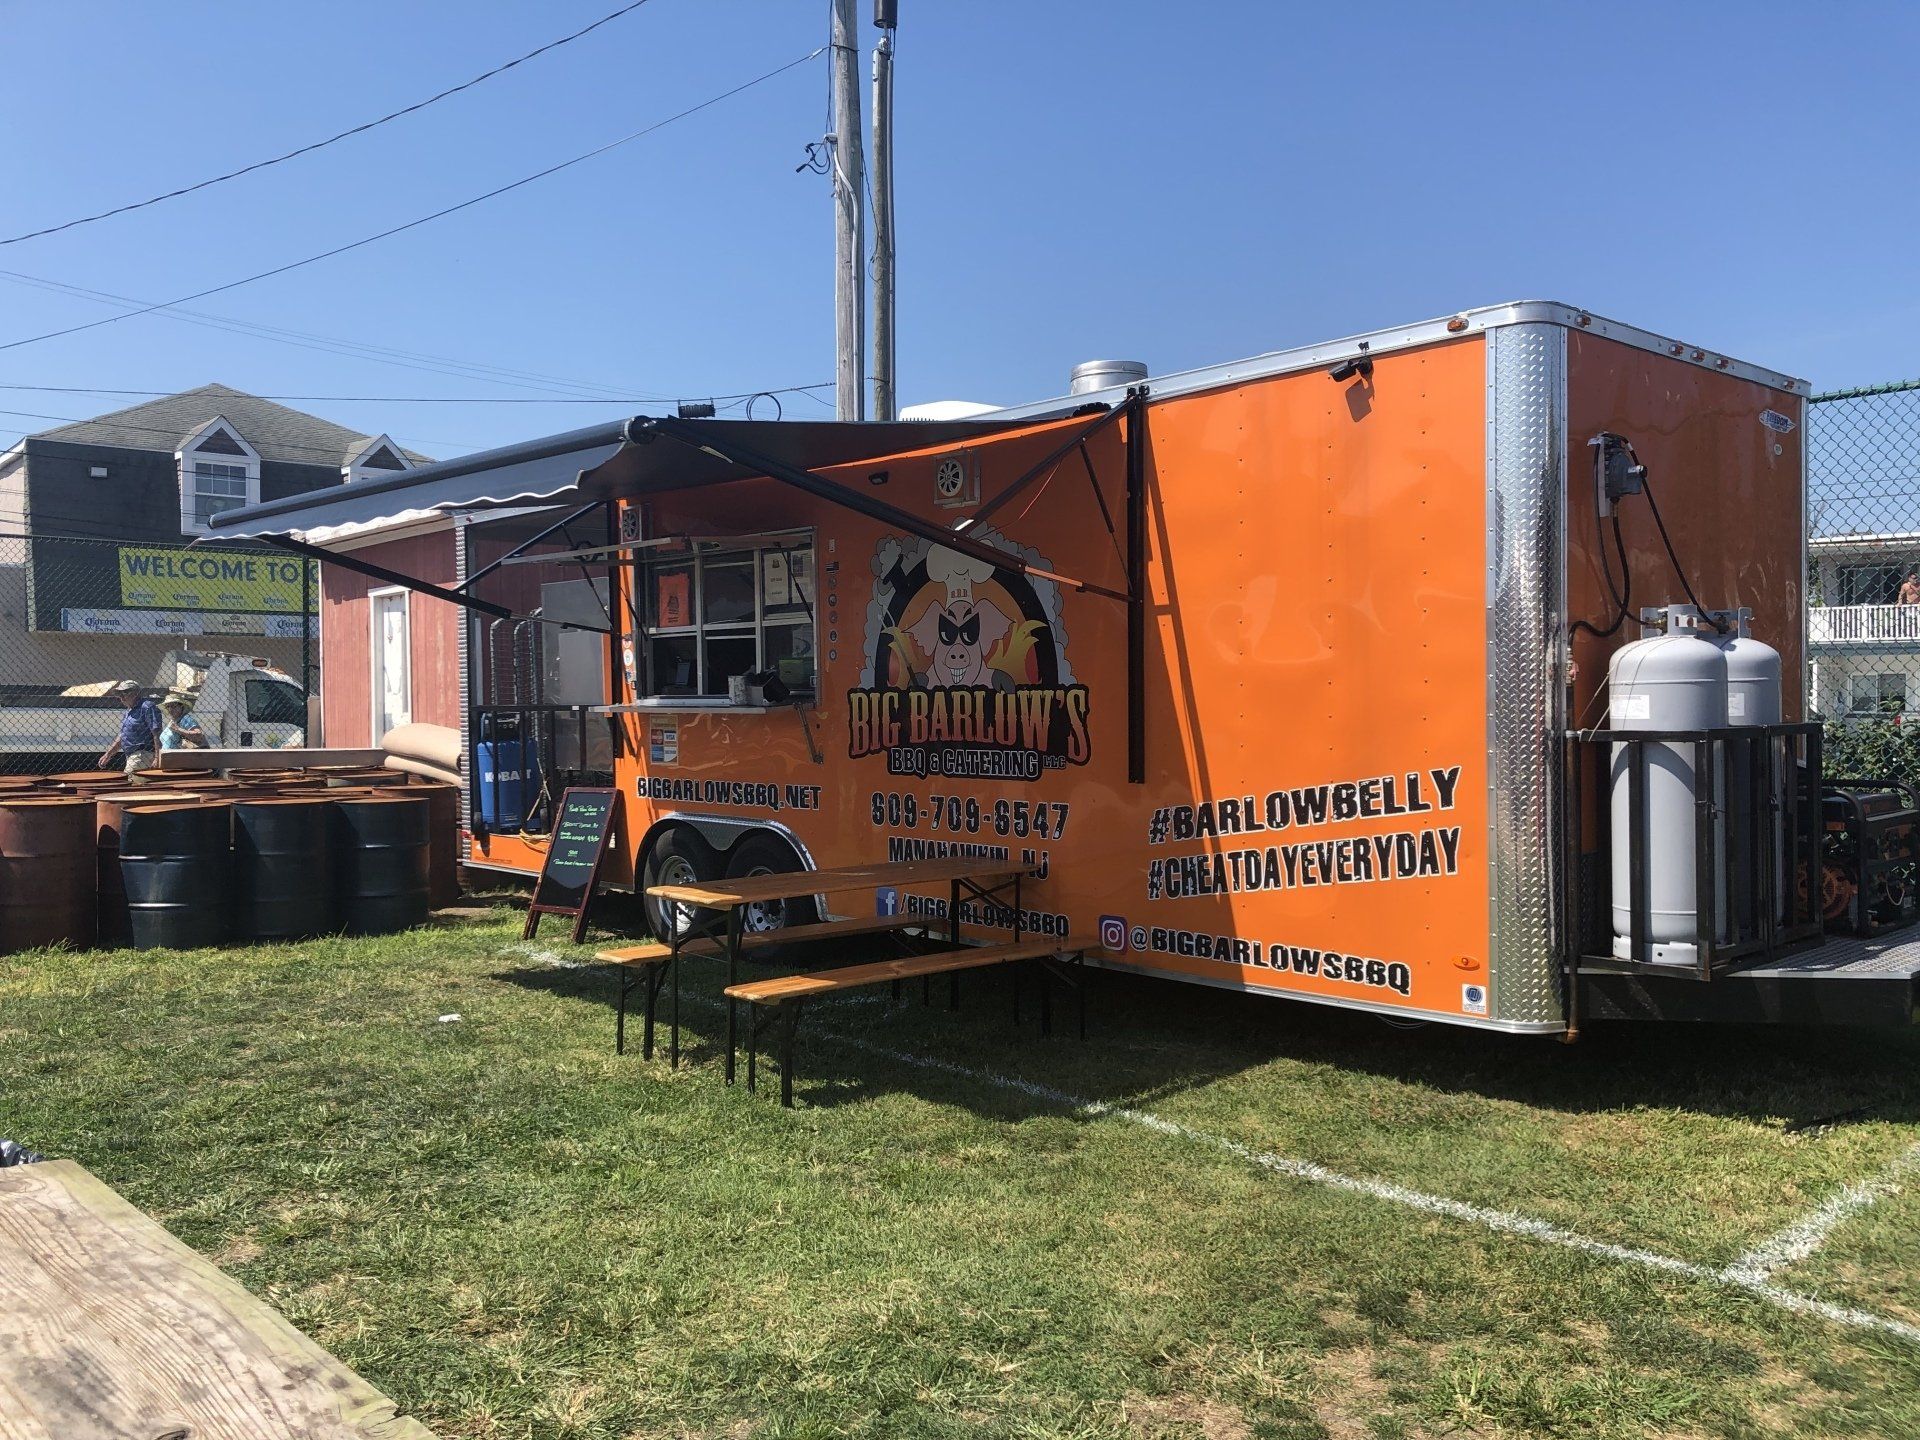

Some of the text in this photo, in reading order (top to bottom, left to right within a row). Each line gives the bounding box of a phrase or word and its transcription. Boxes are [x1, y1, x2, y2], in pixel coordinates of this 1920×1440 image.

[125, 554, 257, 582] WELCOME
[266, 562, 299, 584] TO
[85, 617, 120, 628] Corona
[156, 619, 185, 628] Corona
[222, 620, 246, 628] Corona
[850, 688, 1087, 763] BIG BARLOW'S
[484, 768, 532, 783] KBAT
[891, 748, 1067, 778] BBQ & CATERING LLC
[637, 776, 822, 812] BIGBARLOWSBBQ.NET
[1149, 766, 1462, 844] #BARLOWBELLY
[871, 791, 1069, 840] 609-709-6547
[1022, 848, 1049, 880] NJ
[1148, 826, 1462, 900] #CHEATDAYEVERYDAY
[899, 893, 1070, 937] /BIGBRLOWSBBQ
[1130, 925, 1411, 996] @BIGBARLOWSBBQ
